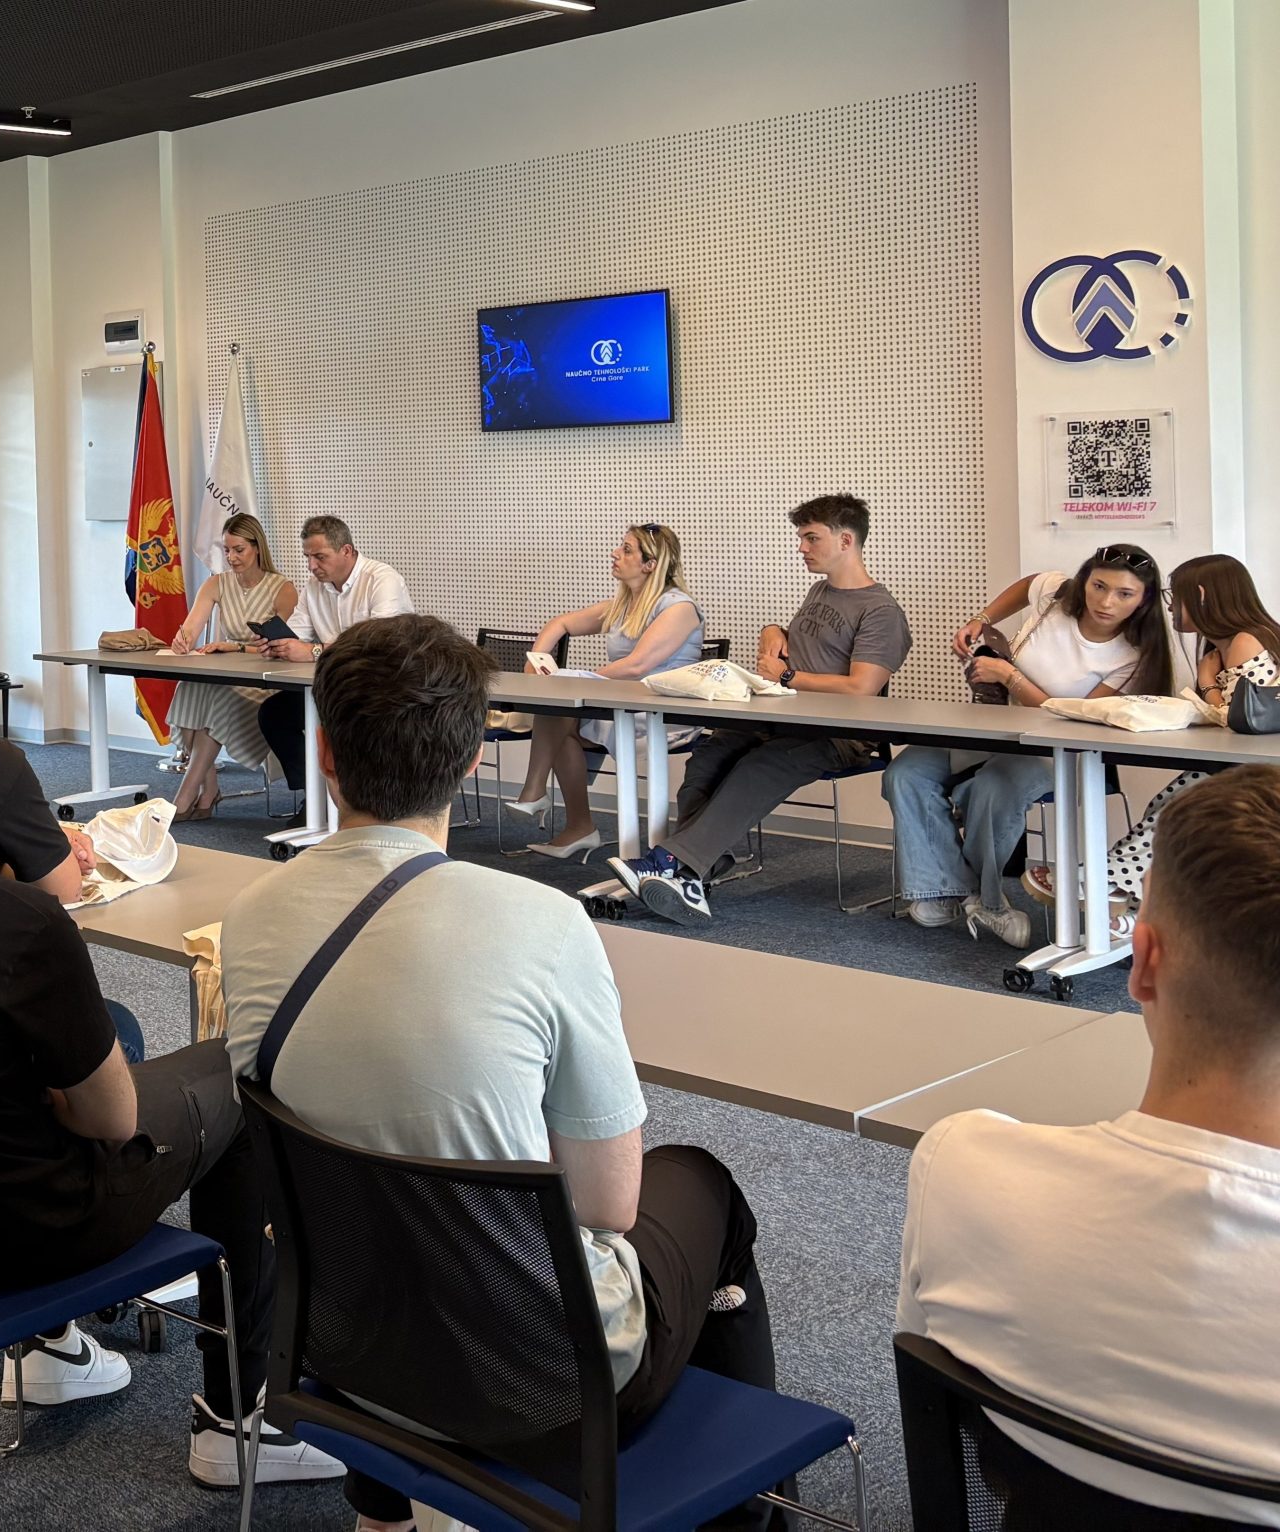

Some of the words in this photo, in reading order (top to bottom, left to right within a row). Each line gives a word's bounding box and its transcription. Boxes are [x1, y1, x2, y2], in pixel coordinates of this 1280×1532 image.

[633, 365, 651, 373] PARK
[205, 476, 240, 516] AUČN
[1064, 502, 1115, 512] TELEKOM
[1116, 501, 1149, 512] WI-FI
[1150, 501, 1157, 512] 7
